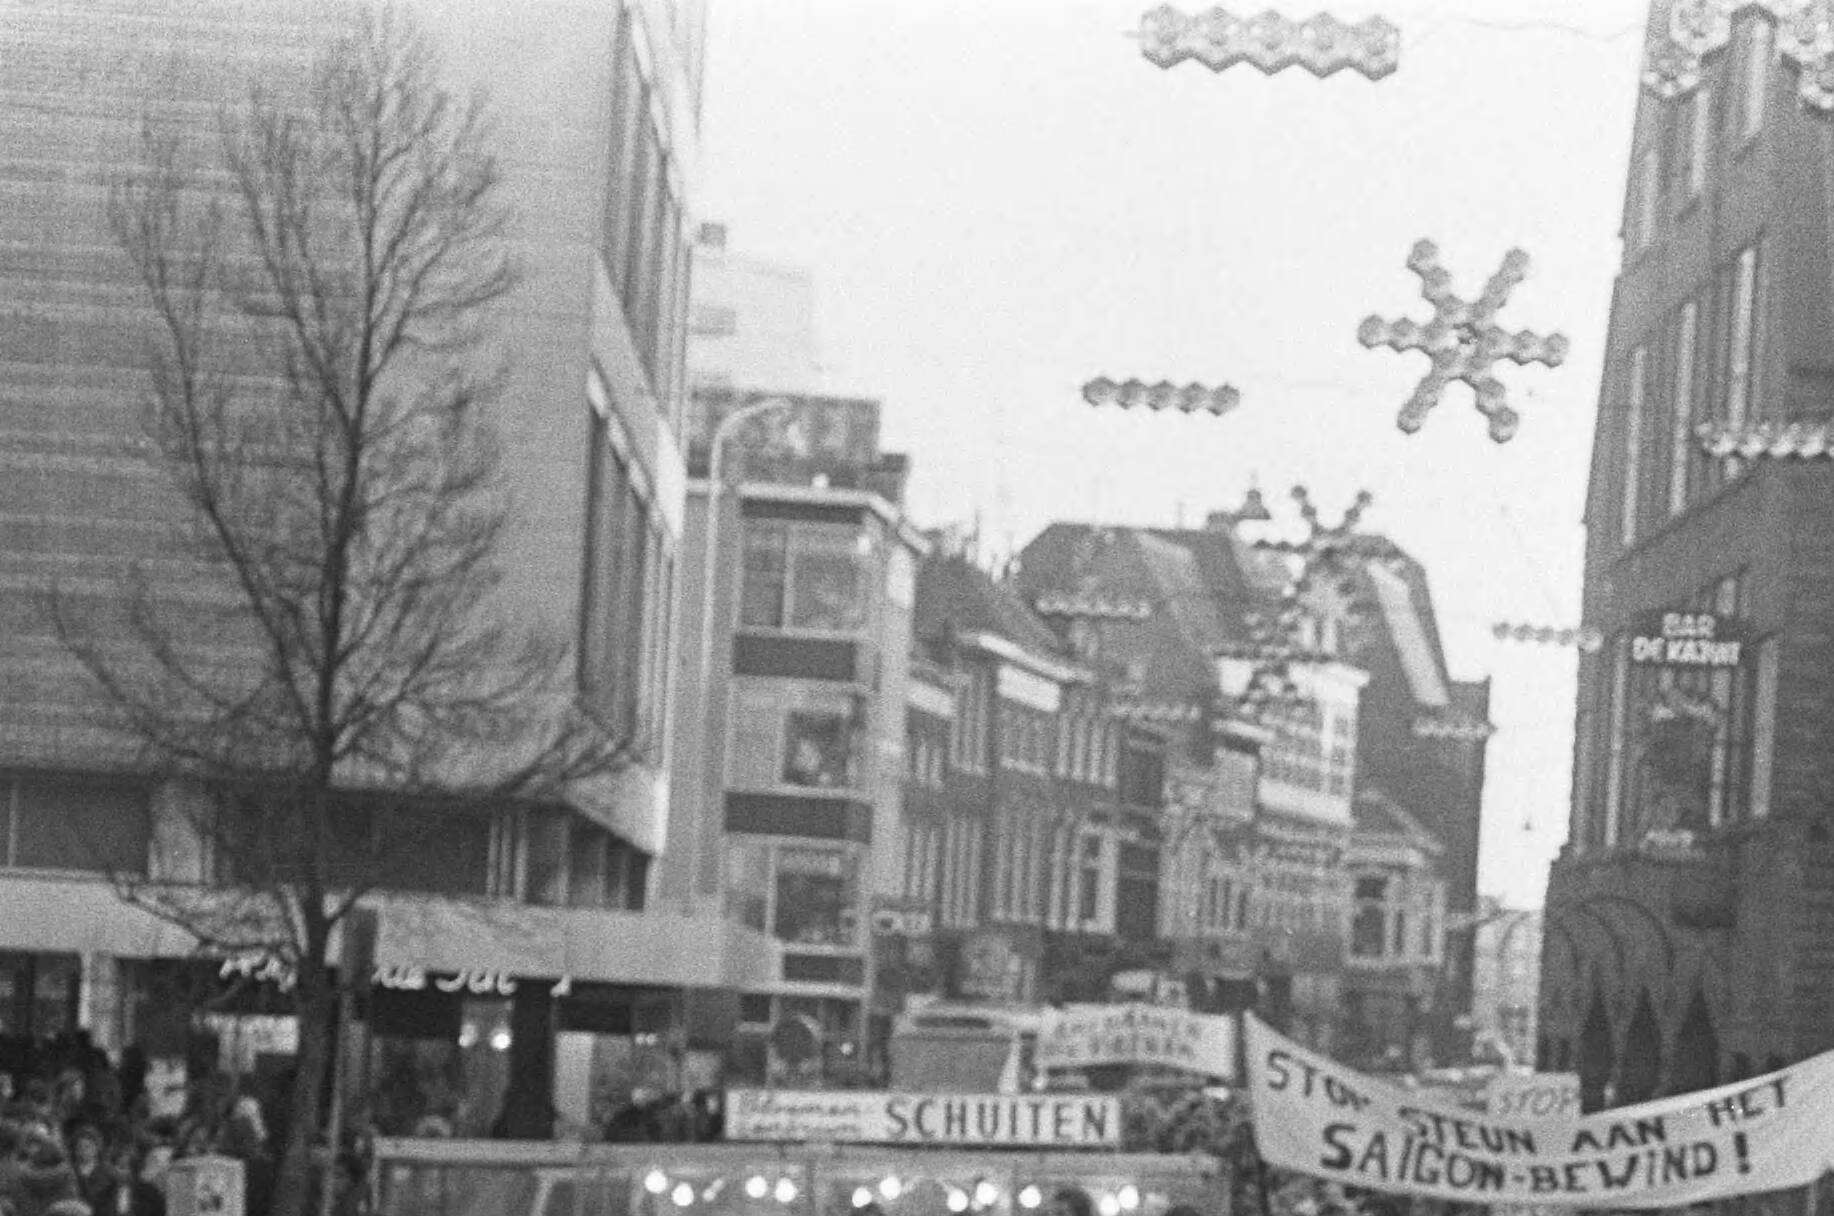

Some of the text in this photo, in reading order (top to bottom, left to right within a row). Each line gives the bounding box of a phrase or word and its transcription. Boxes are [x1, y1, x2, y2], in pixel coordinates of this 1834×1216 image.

[884, 1094, 1110, 1142] SCHUITEN
[1402, 1076, 1790, 1155] STEUN AAN HET
